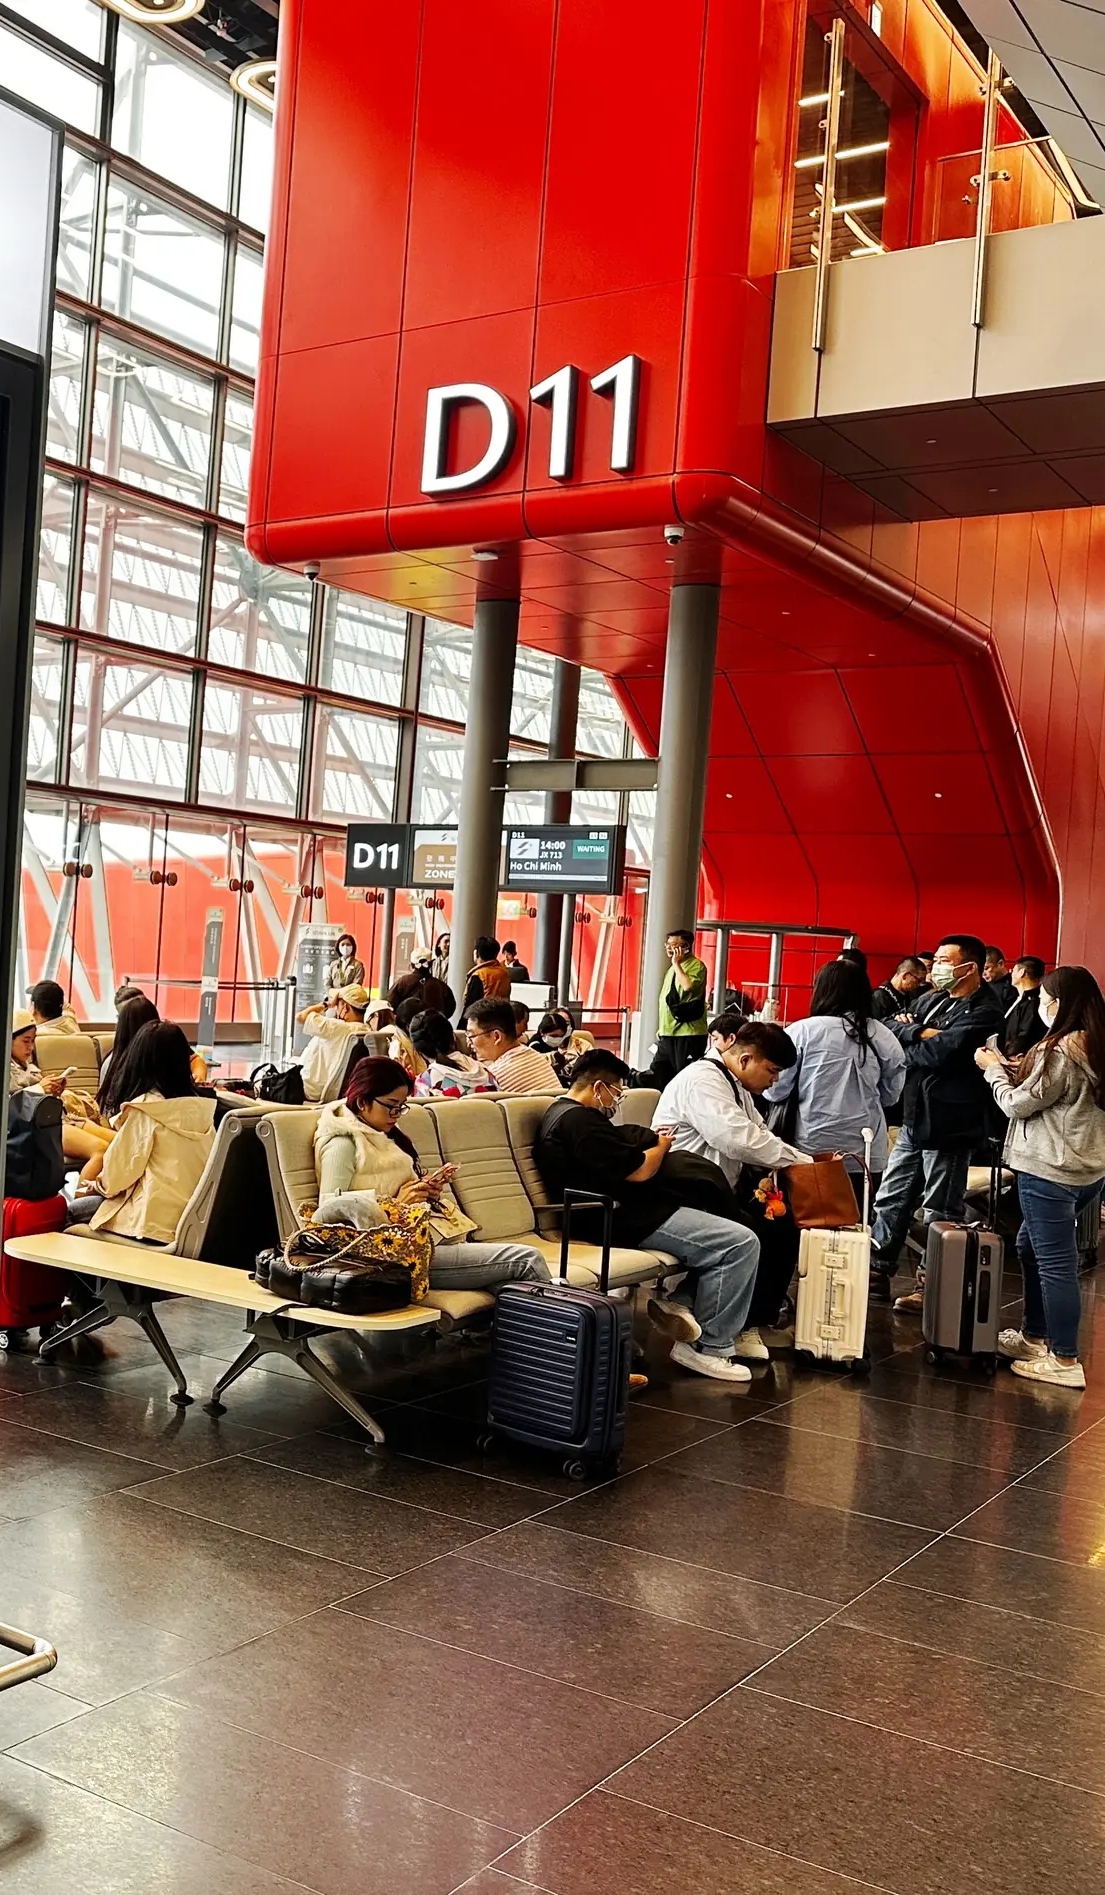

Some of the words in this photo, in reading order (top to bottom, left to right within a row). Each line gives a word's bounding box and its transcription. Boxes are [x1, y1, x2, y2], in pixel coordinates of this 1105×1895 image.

[421, 354, 640, 496] D11
[540, 841, 566, 849] 14:00
[352, 842, 400, 870] D11
[510, 862, 522, 870] Ho
[524, 862, 538, 870] Chi
[540, 862, 562, 871] Minh
[425, 870, 455, 878] ZONE
